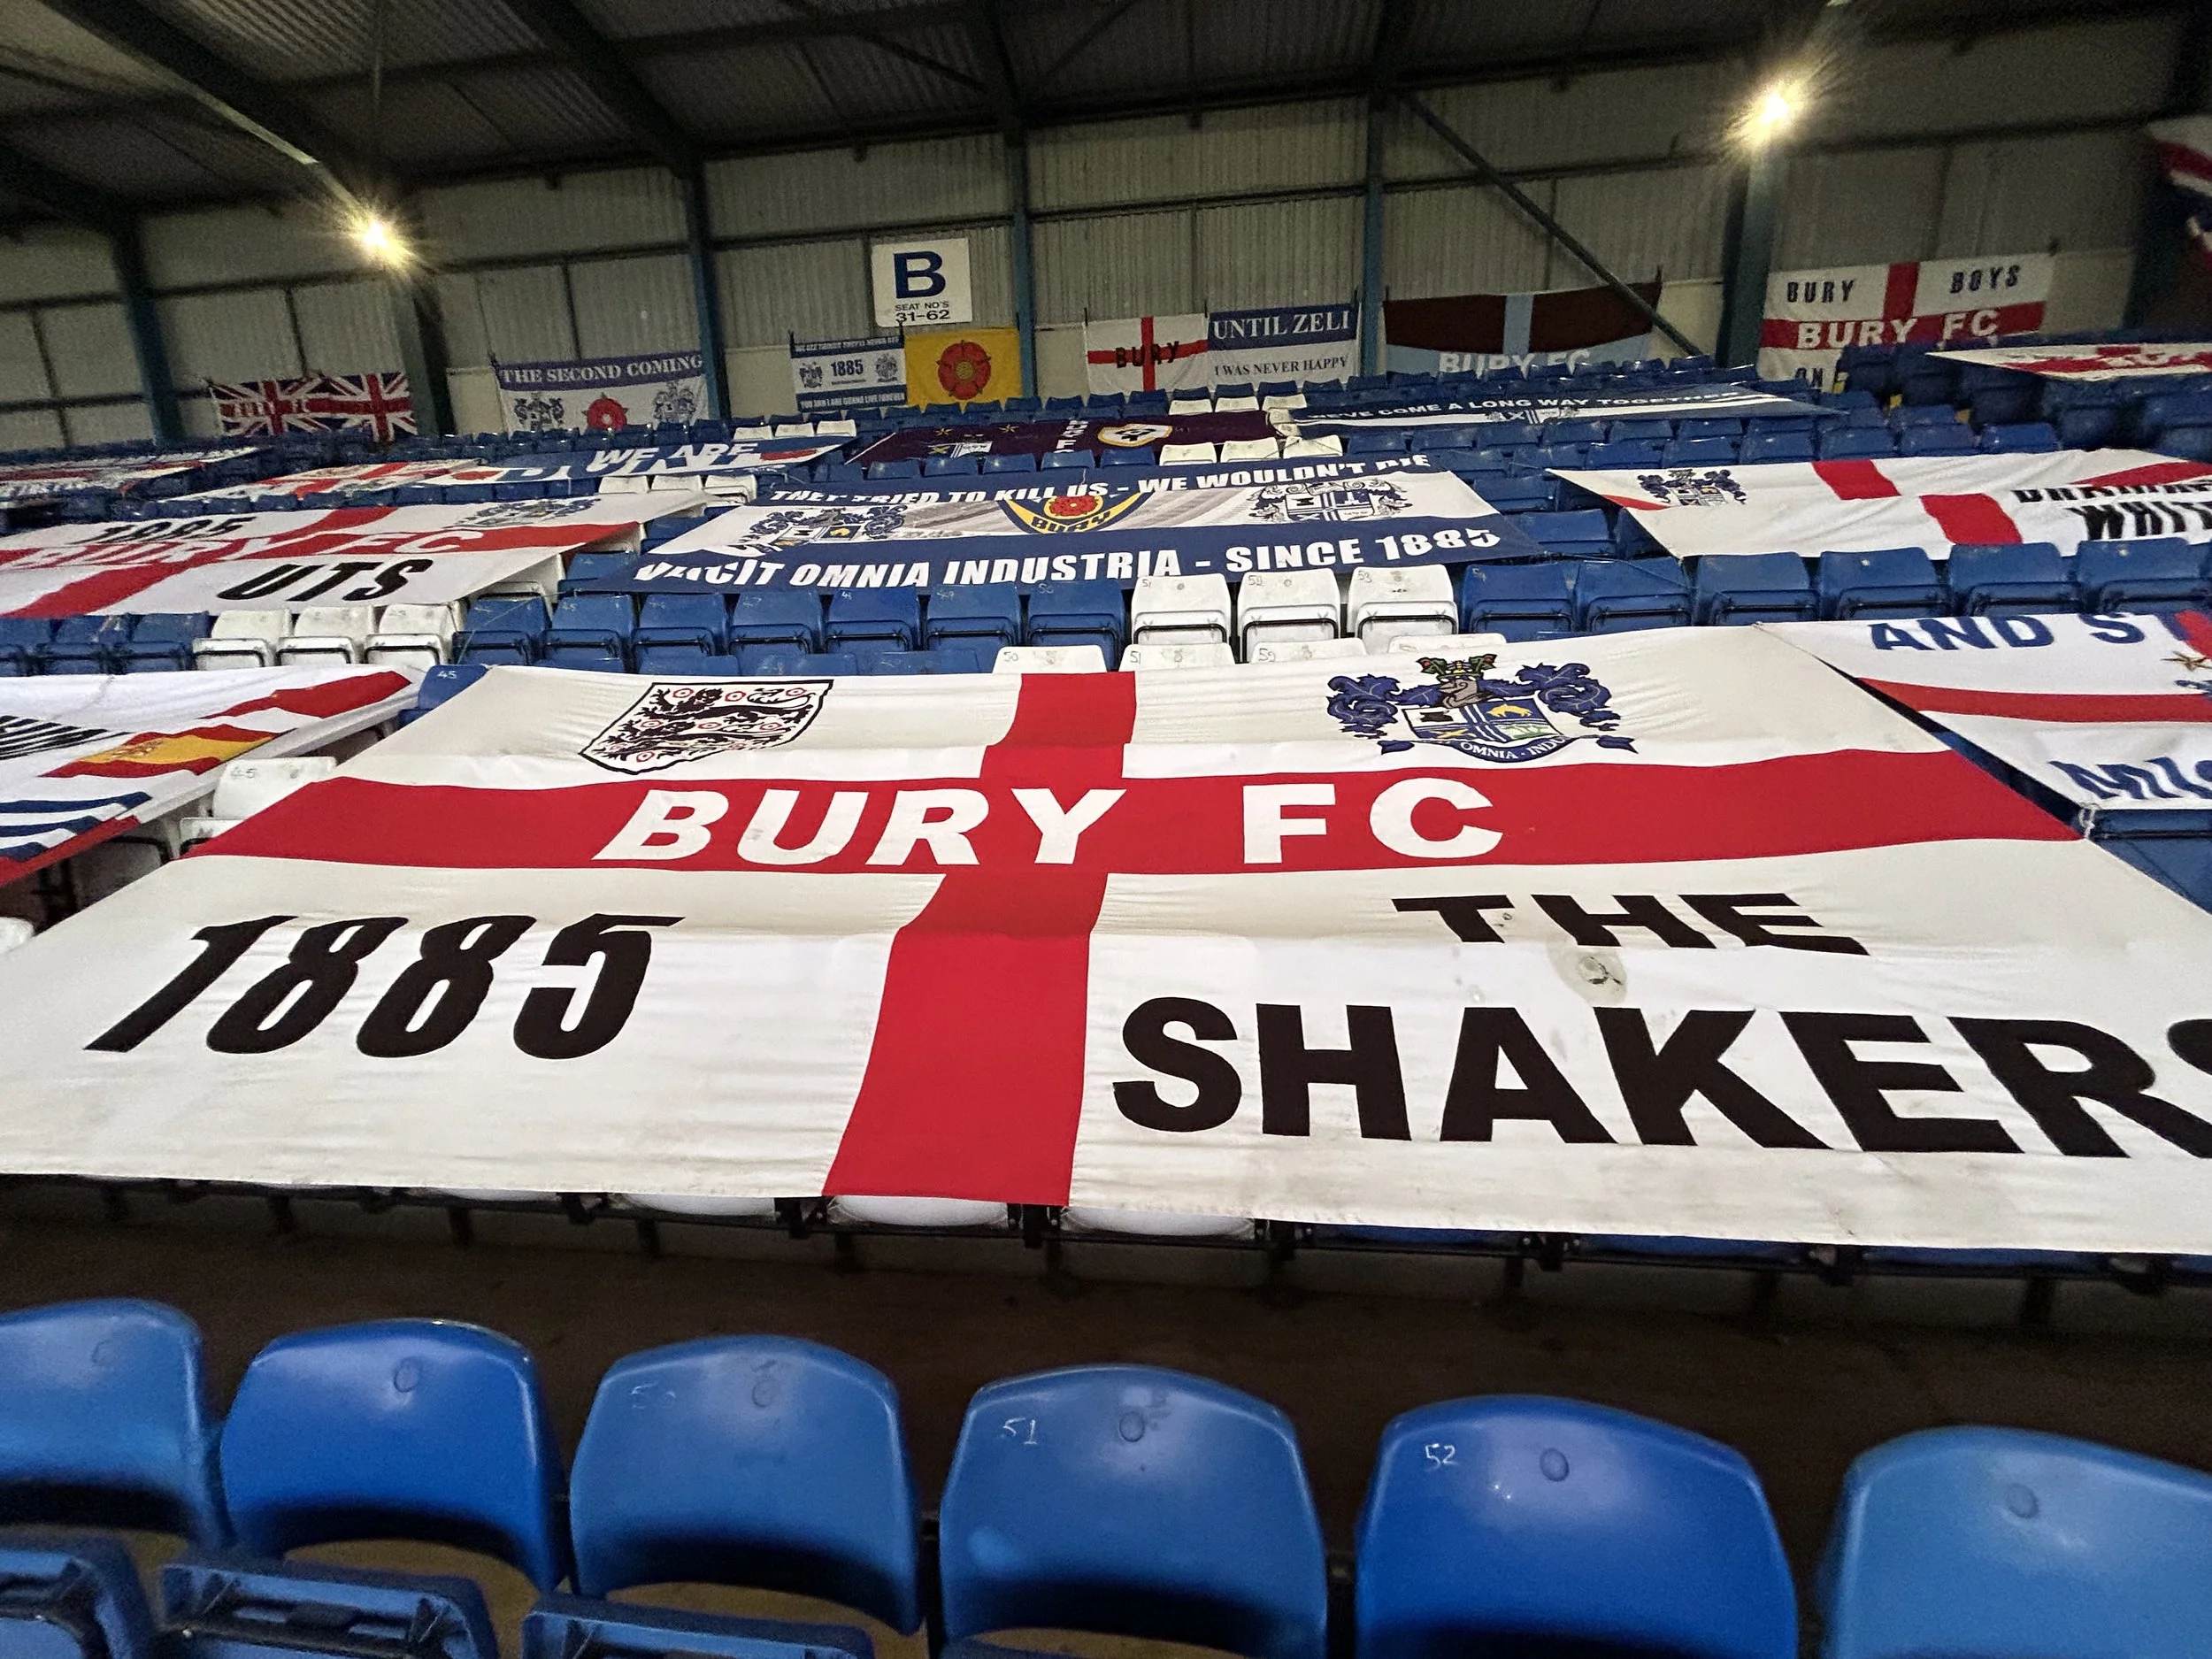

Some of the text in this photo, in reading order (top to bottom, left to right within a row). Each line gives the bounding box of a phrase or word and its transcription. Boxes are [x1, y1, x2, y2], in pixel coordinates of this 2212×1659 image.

[893, 250, 947, 299] B
[1948, 265, 2021, 294] BOYS
[1786, 280, 1856, 303] BURY
[895, 303, 921, 311] SEAT
[895, 310, 950, 323] 31-62
[1213, 317, 1287, 340] UNTIL
[1796, 310, 2000, 349] BURY FC
[831, 358, 864, 377] 1885
[1116, 341, 1179, 368] BURY
[1214, 356, 1349, 376] I WAS NEVER HAPPY
[501, 354, 703, 384] THE SECOND COMING
[1379, 403, 1441, 416] COME
[1448, 402, 1463, 411] A
[1469, 399, 1532, 409] LONG
[1538, 398, 1589, 407] WAY
[770, 490, 848, 503] THEY
[851, 491, 940, 504] TRIED
[941, 490, 987, 503] TO
[994, 486, 1061, 503] KILL
[1066, 481, 1110, 497] US
[1139, 476, 1187, 493] WE
[1196, 462, 1366, 488] WOULDN'T
[1031, 511, 1111, 532] BURY
[316, 531, 485, 555] FC
[789, 561, 930, 588] OMNIA
[942, 549, 1182, 585] INDUSTRIA
[1225, 538, 1365, 572] SINCE
[1375, 528, 1502, 561] 1885
[217, 558, 434, 602] UTS
[1868, 615, 2055, 650] AND
[437, 671, 457, 680] 45
[1461, 741, 1519, 760] OMNIA
[592, 777, 1503, 865] BURY FC
[1391, 893, 1871, 956] THE
[83, 912, 686, 1060] 1885
[1002, 1417, 1037, 1446] 51
[1424, 1442, 1456, 1468] 52
